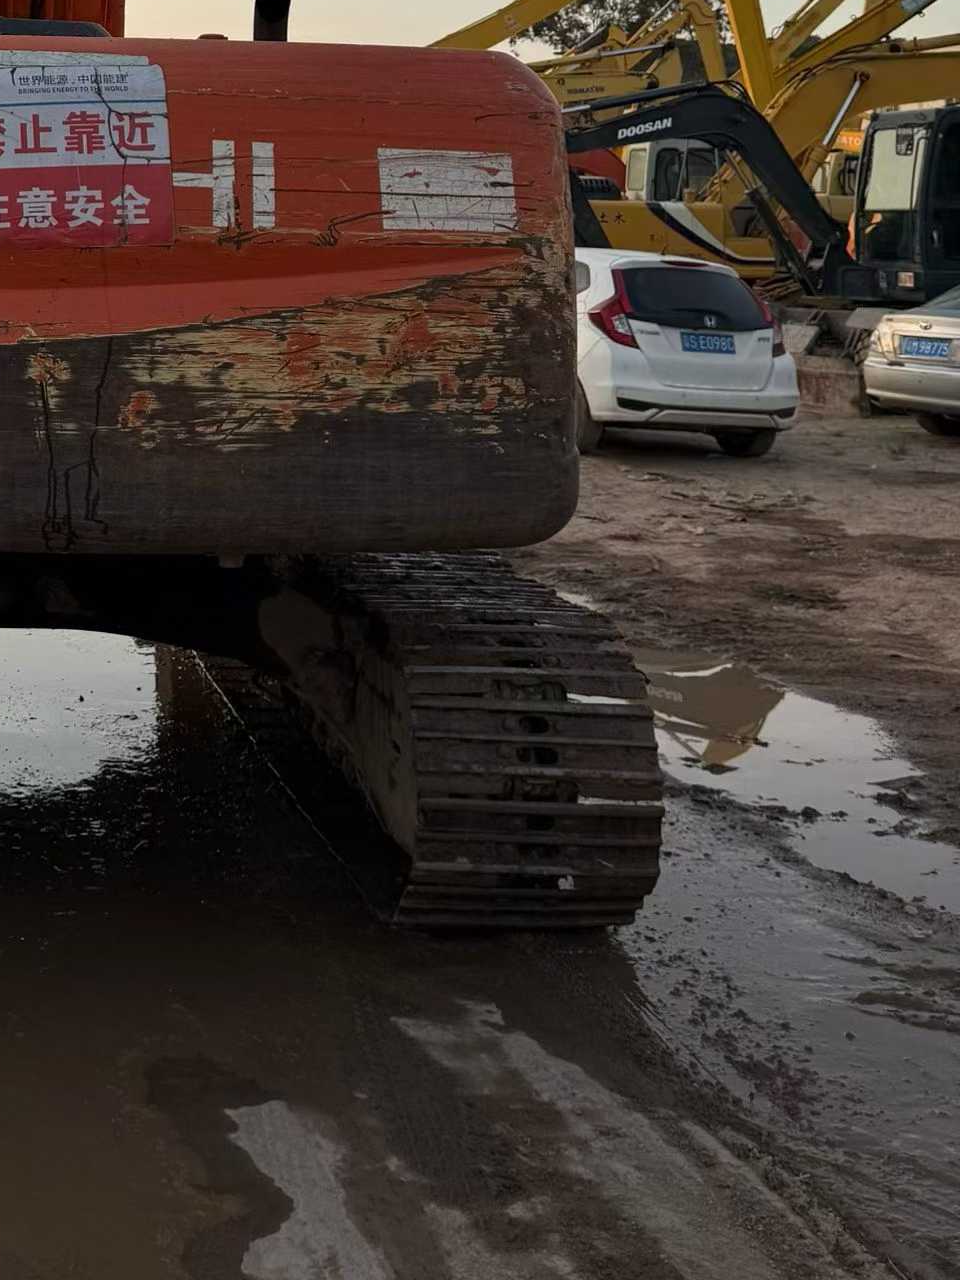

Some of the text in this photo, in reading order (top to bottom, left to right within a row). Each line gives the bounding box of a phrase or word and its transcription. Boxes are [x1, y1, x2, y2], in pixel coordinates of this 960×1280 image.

[18, 87, 51, 95] BRINGING
[52, 86, 78, 94] ENERGY
[104, 85, 128, 93] WORLD
[617, 117, 672, 139] DOOSAN
